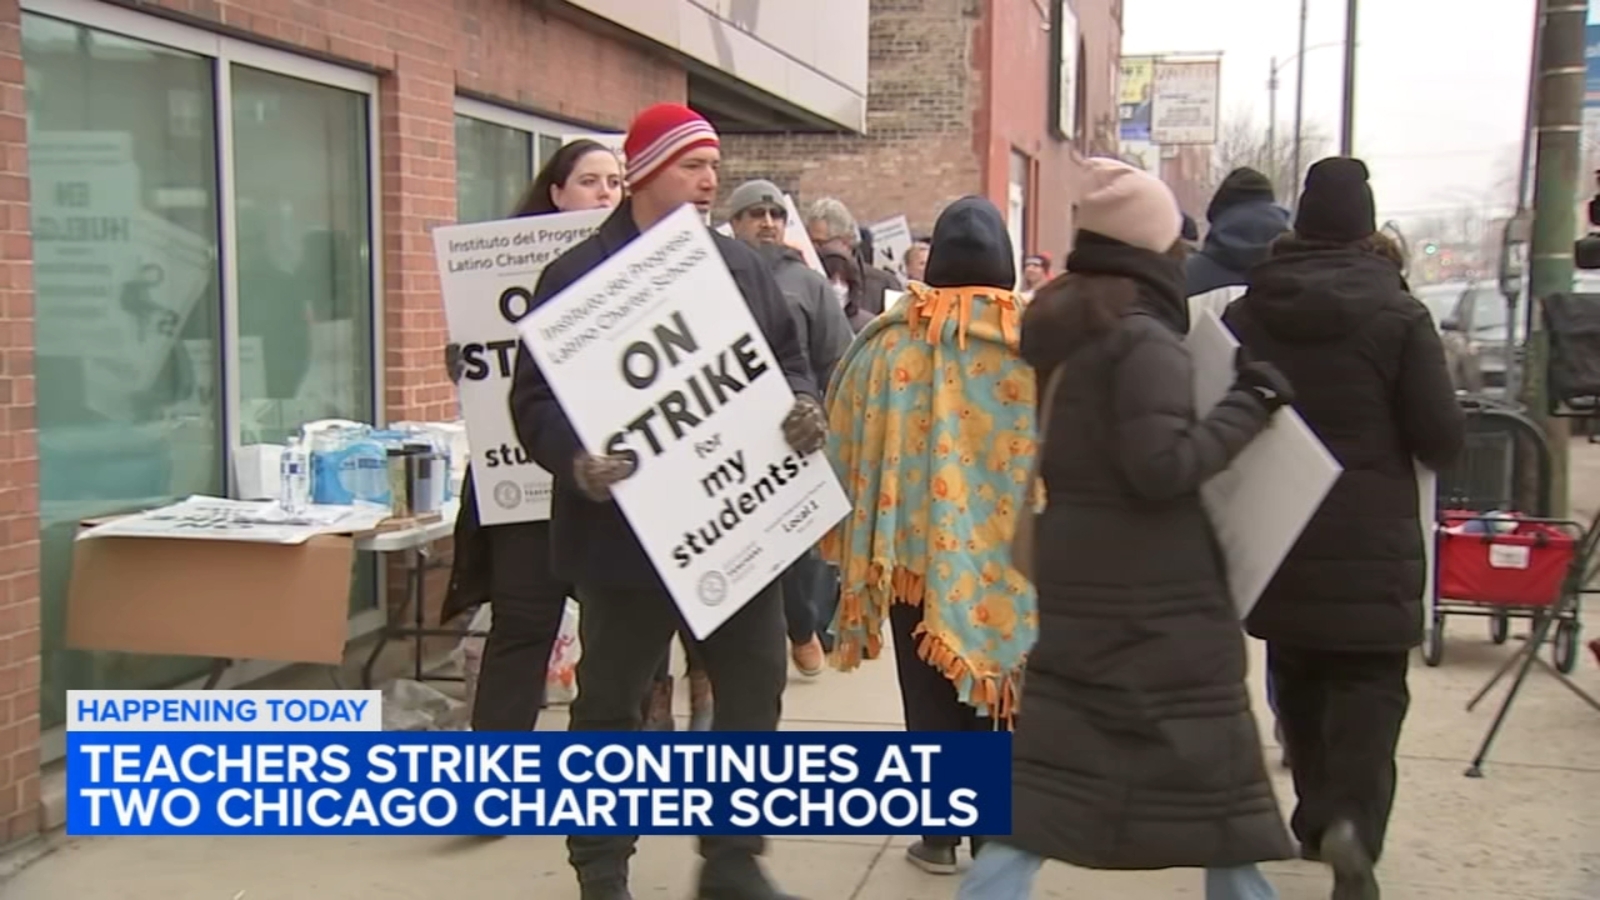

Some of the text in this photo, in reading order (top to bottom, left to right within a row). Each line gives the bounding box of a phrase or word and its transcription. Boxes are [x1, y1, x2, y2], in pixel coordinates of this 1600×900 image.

[449, 235, 509, 252] Instituto
[513, 231, 535, 247] del
[449, 254, 492, 272] Latino
[496, 251, 549, 268] Charter
[499, 286, 533, 323] O
[622, 310, 699, 389] ON
[604, 332, 769, 482] STRIKE
[694, 433, 721, 458] for
[701, 449, 747, 498] my
